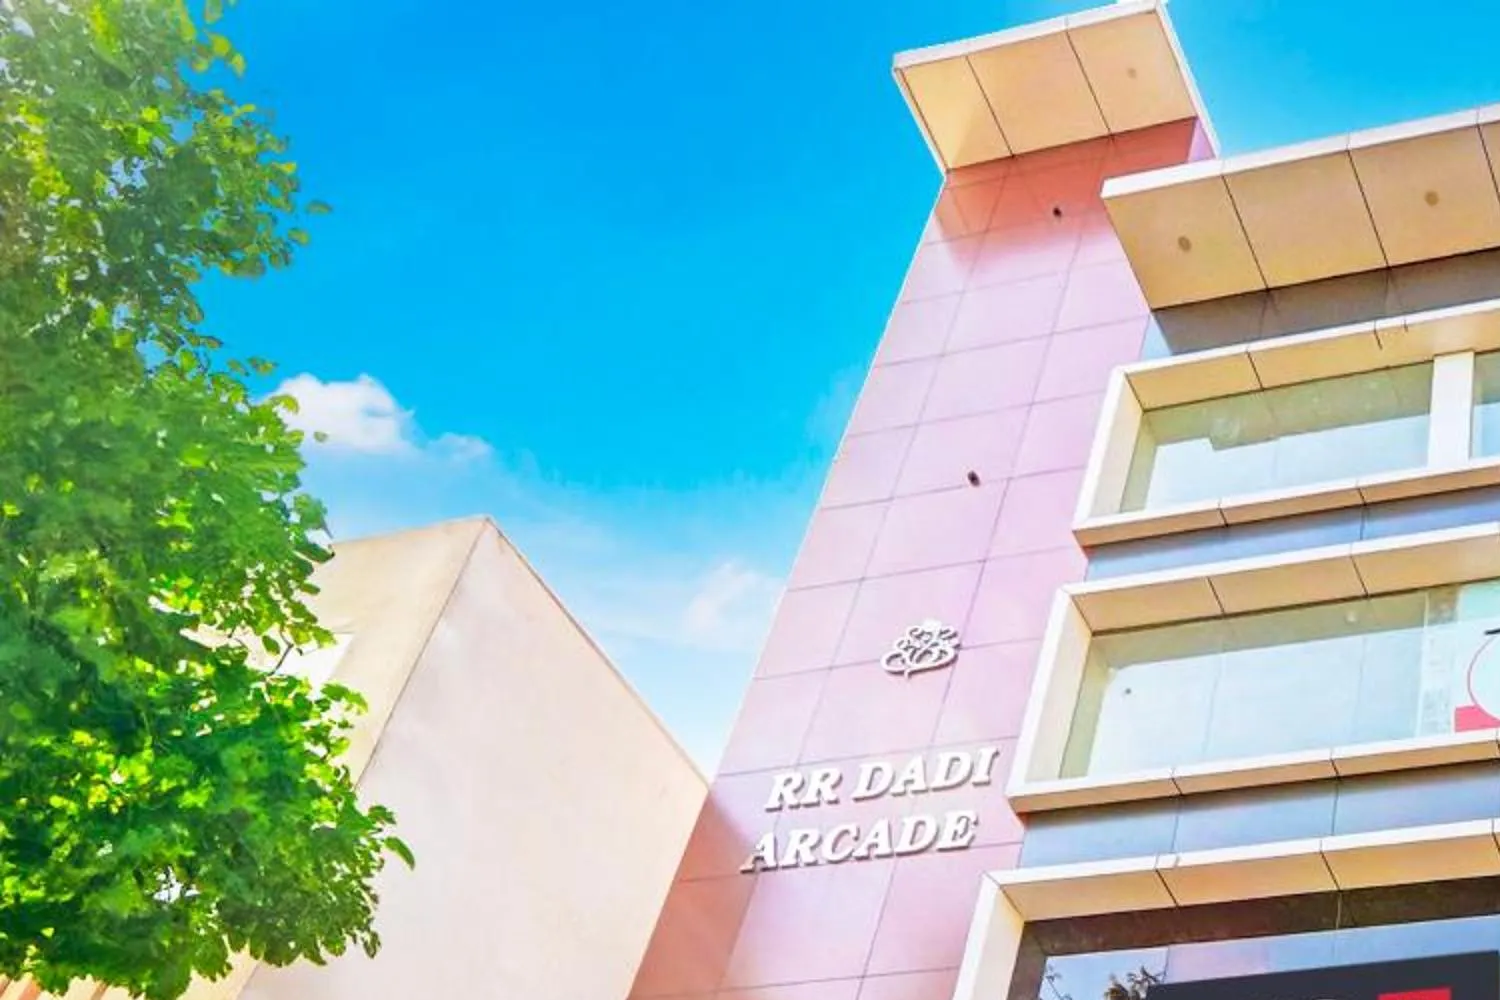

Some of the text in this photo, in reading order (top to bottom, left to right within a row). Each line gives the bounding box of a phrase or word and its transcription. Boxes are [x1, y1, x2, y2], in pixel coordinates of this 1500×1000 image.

[765, 747, 1000, 812] RR DADI
[740, 810, 980, 874] ARCADE
